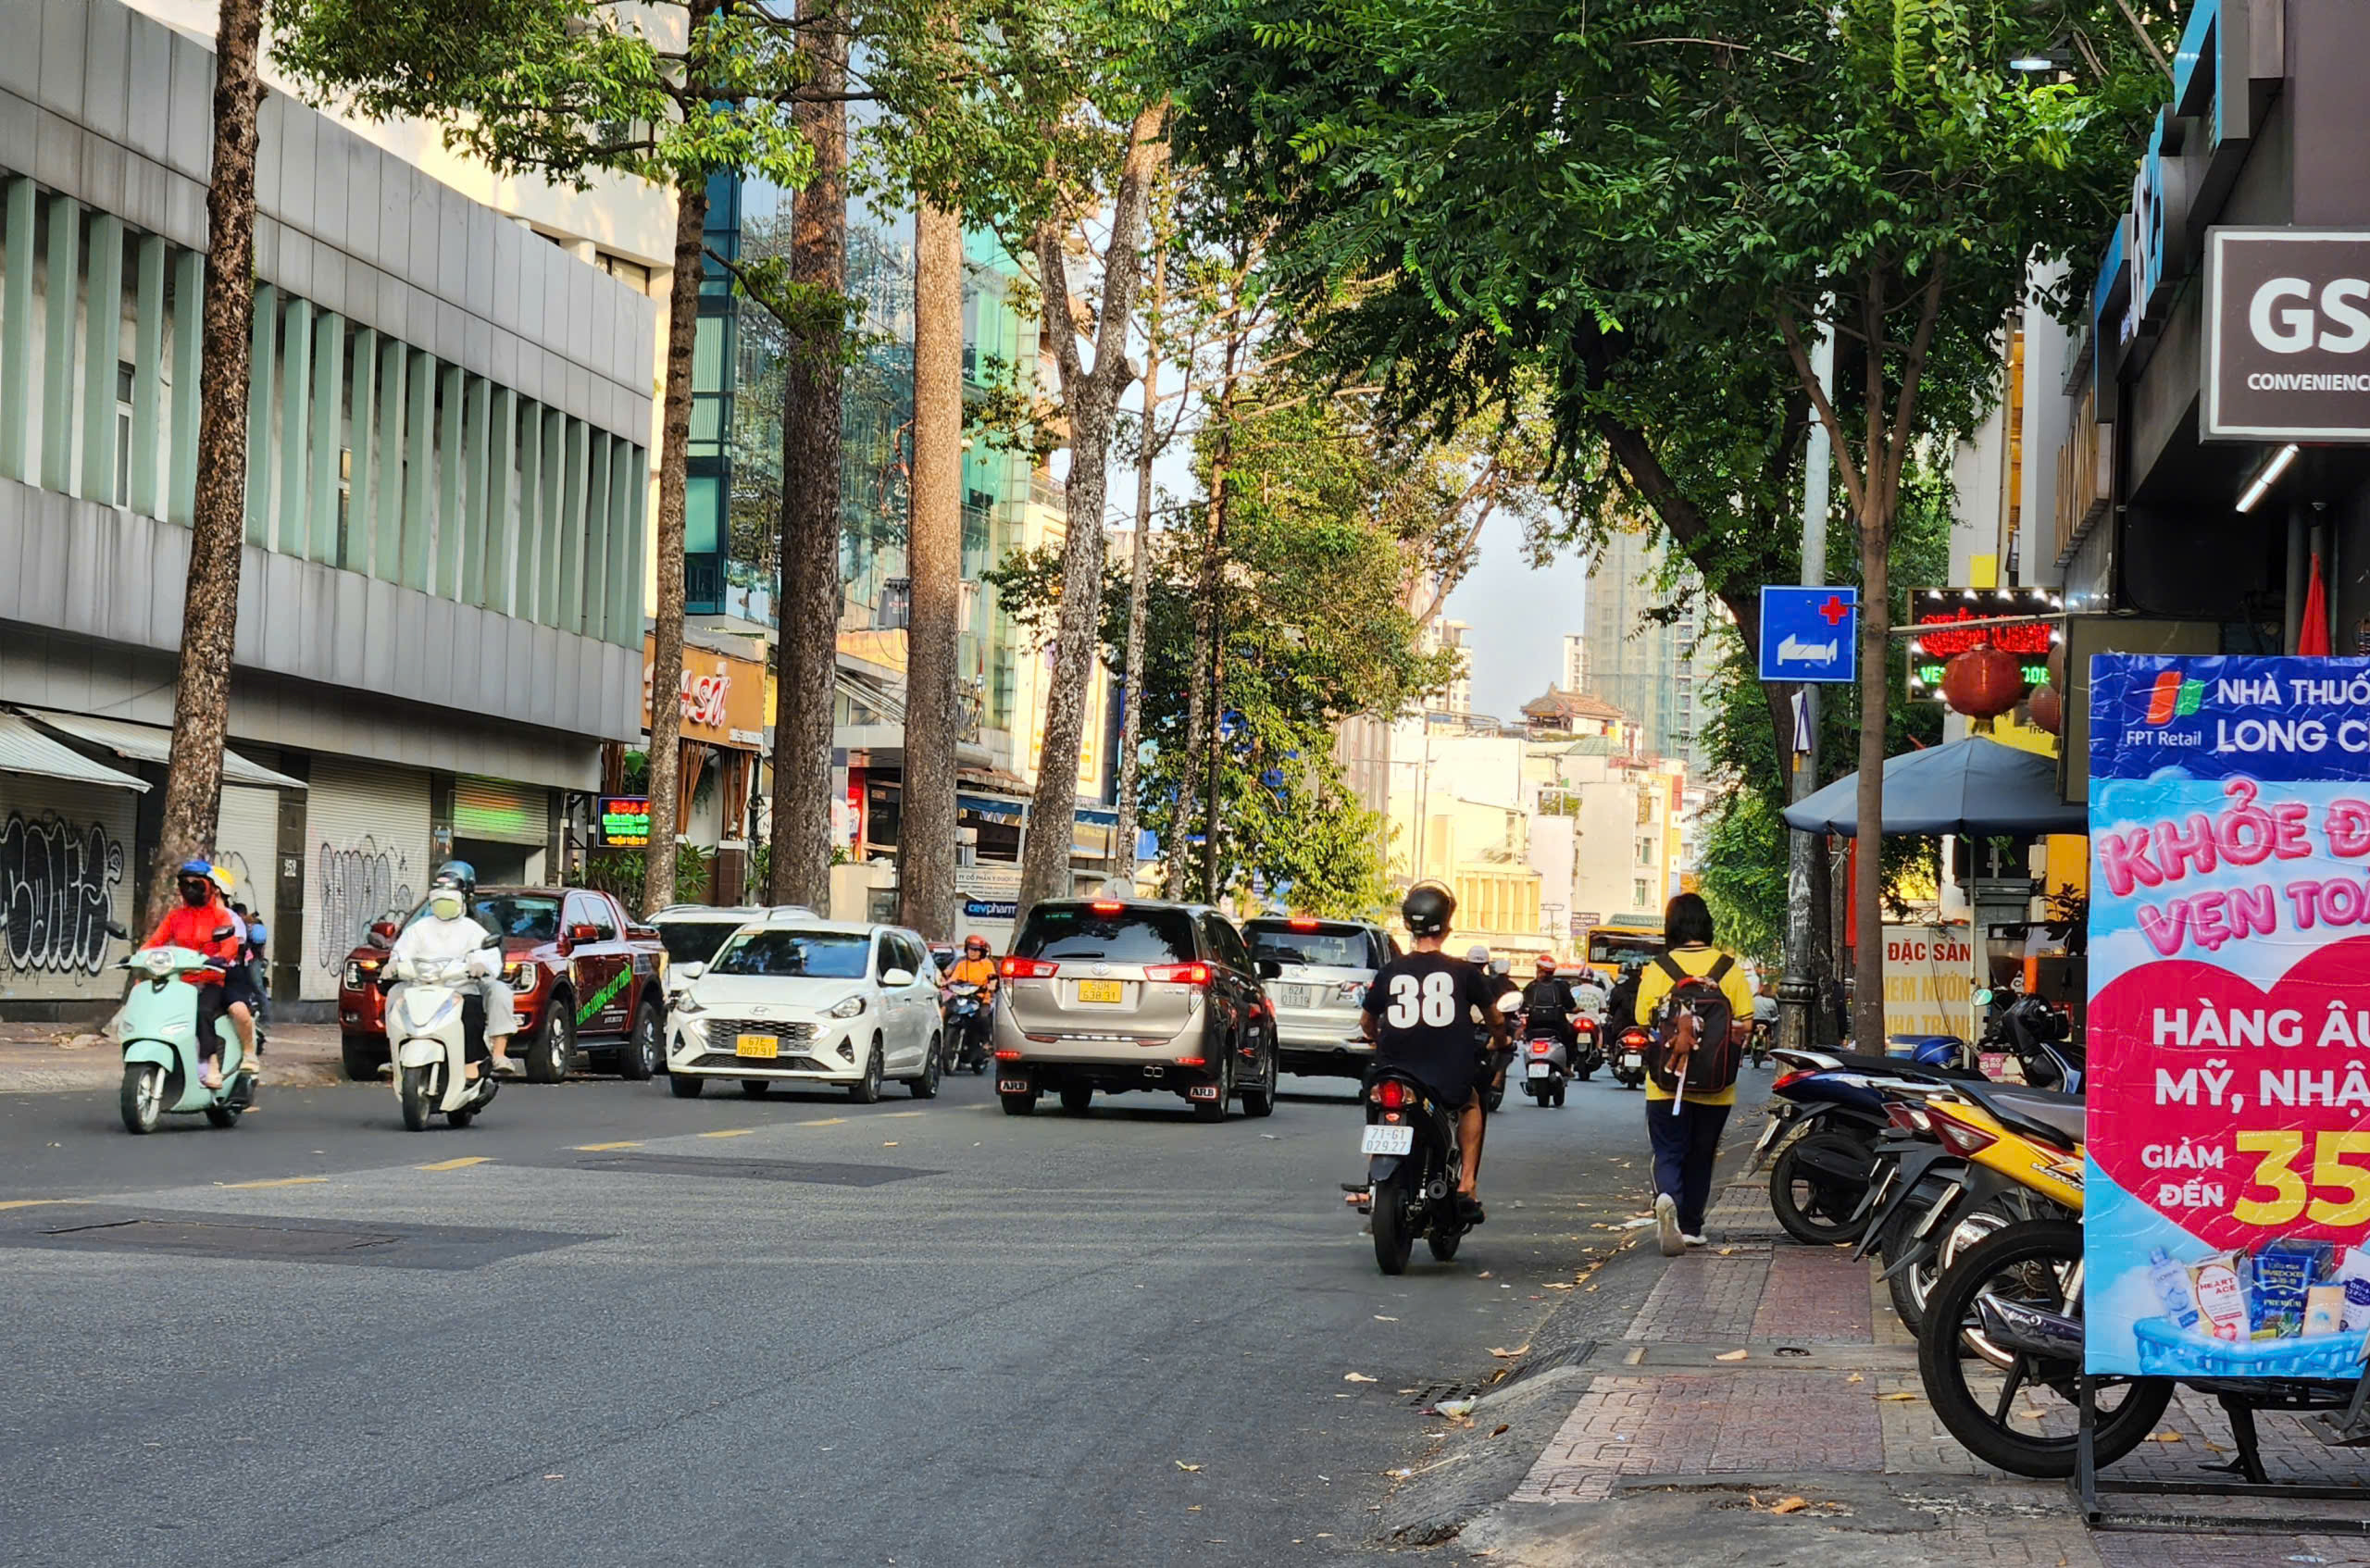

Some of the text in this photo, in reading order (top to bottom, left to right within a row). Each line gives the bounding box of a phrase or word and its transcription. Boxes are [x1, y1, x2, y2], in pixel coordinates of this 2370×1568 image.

[2247, 372, 2370, 392] CONVENIENC
[2217, 671, 2280, 705] NHÀ
[2127, 729, 2202, 746] FPT Retail
[2216, 719, 2370, 753] LONG C
[2098, 779, 2313, 896] KHỎE
[2138, 877, 2370, 957] VẸN TO
[1888, 936, 1971, 965] ĐẶC SẢN
[1388, 971, 1455, 1028] 38
[2152, 998, 2303, 1048] HÀNG
[1002, 1081, 1026, 1091] ARB
[1191, 1088, 1216, 1097] ARB
[2155, 1059, 2244, 1114] MỸ,
[2141, 1137, 2224, 1169] GIẢM
[2159, 1176, 2224, 1207] ĐẾN
[2232, 1130, 2370, 1226] 35
[2200, 1277, 2235, 1290] HEART
[2215, 1285, 2237, 1294] ACE
